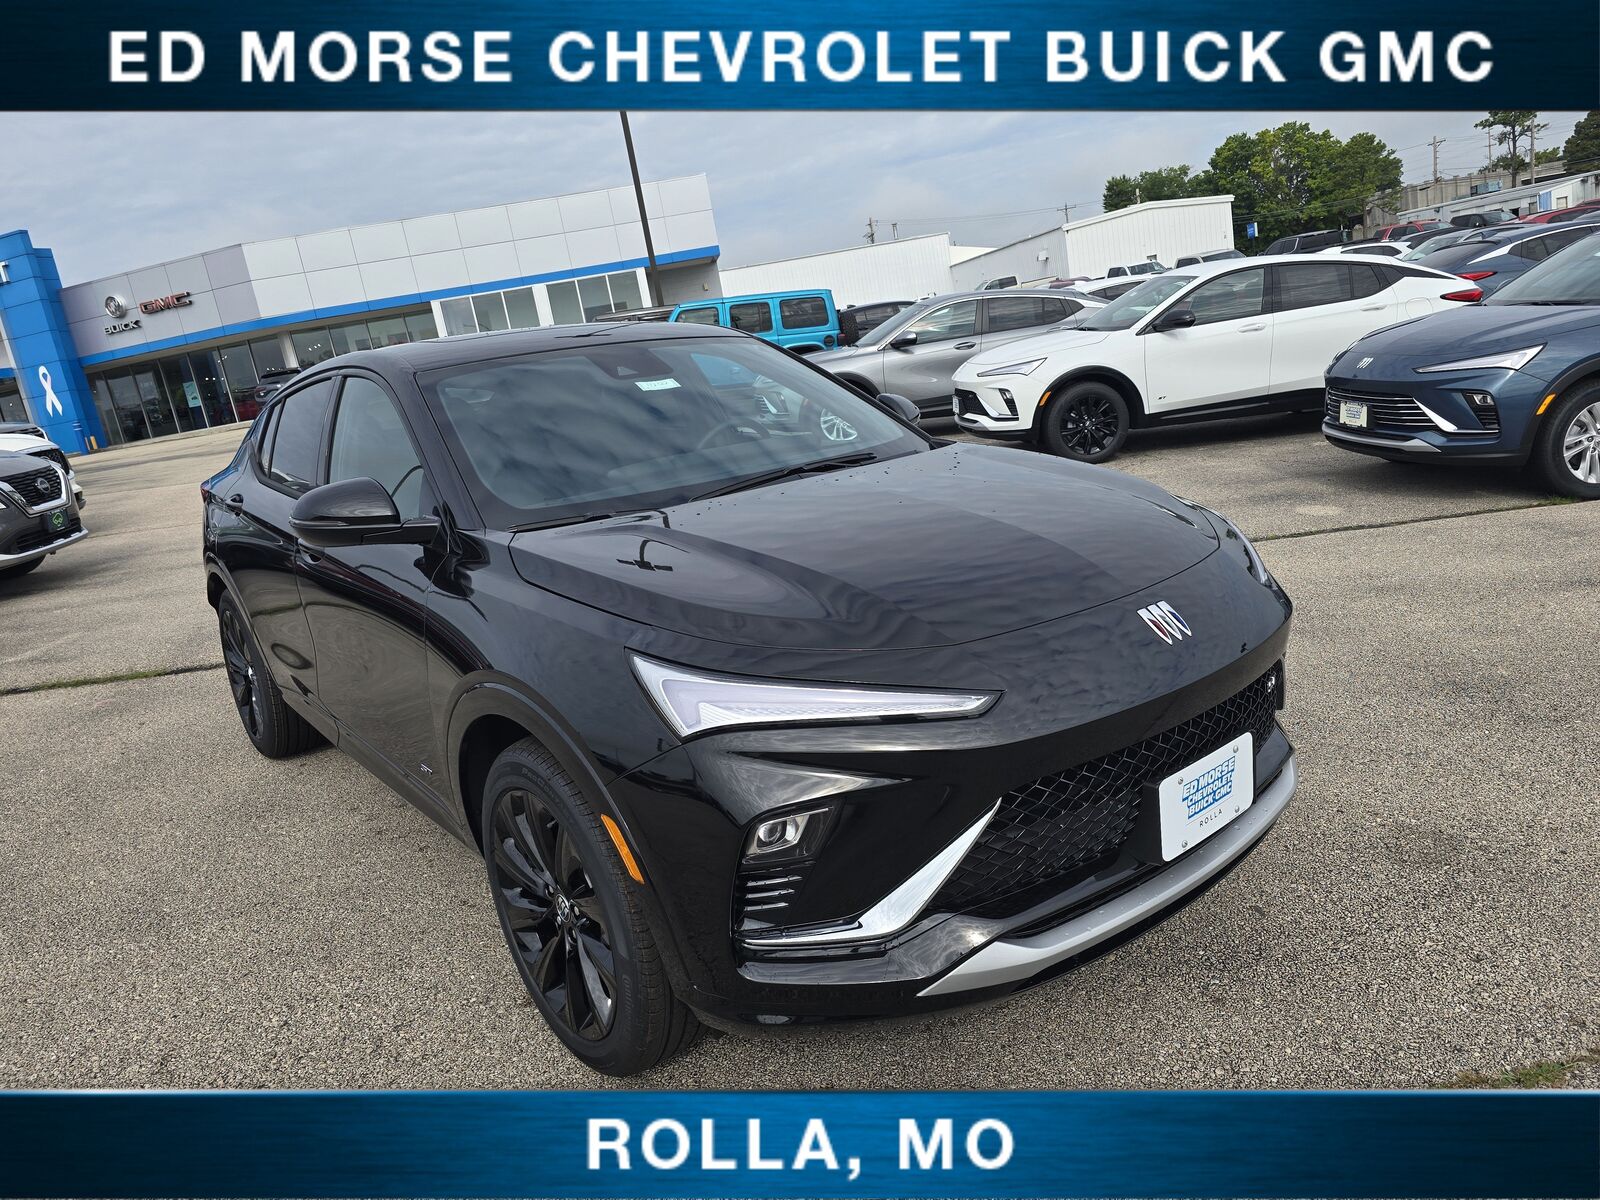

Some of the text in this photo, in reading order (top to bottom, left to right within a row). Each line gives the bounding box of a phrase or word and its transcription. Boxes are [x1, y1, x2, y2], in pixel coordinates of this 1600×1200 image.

[139, 291, 192, 314] GMC
[104, 320, 140, 335] BUICK
[1182, 755, 1235, 802] ED MORSE
[1187, 772, 1232, 808] CHEVROLET
[1188, 780, 1232, 819] BUICK GMC
[1199, 808, 1222, 828] ROLLA
